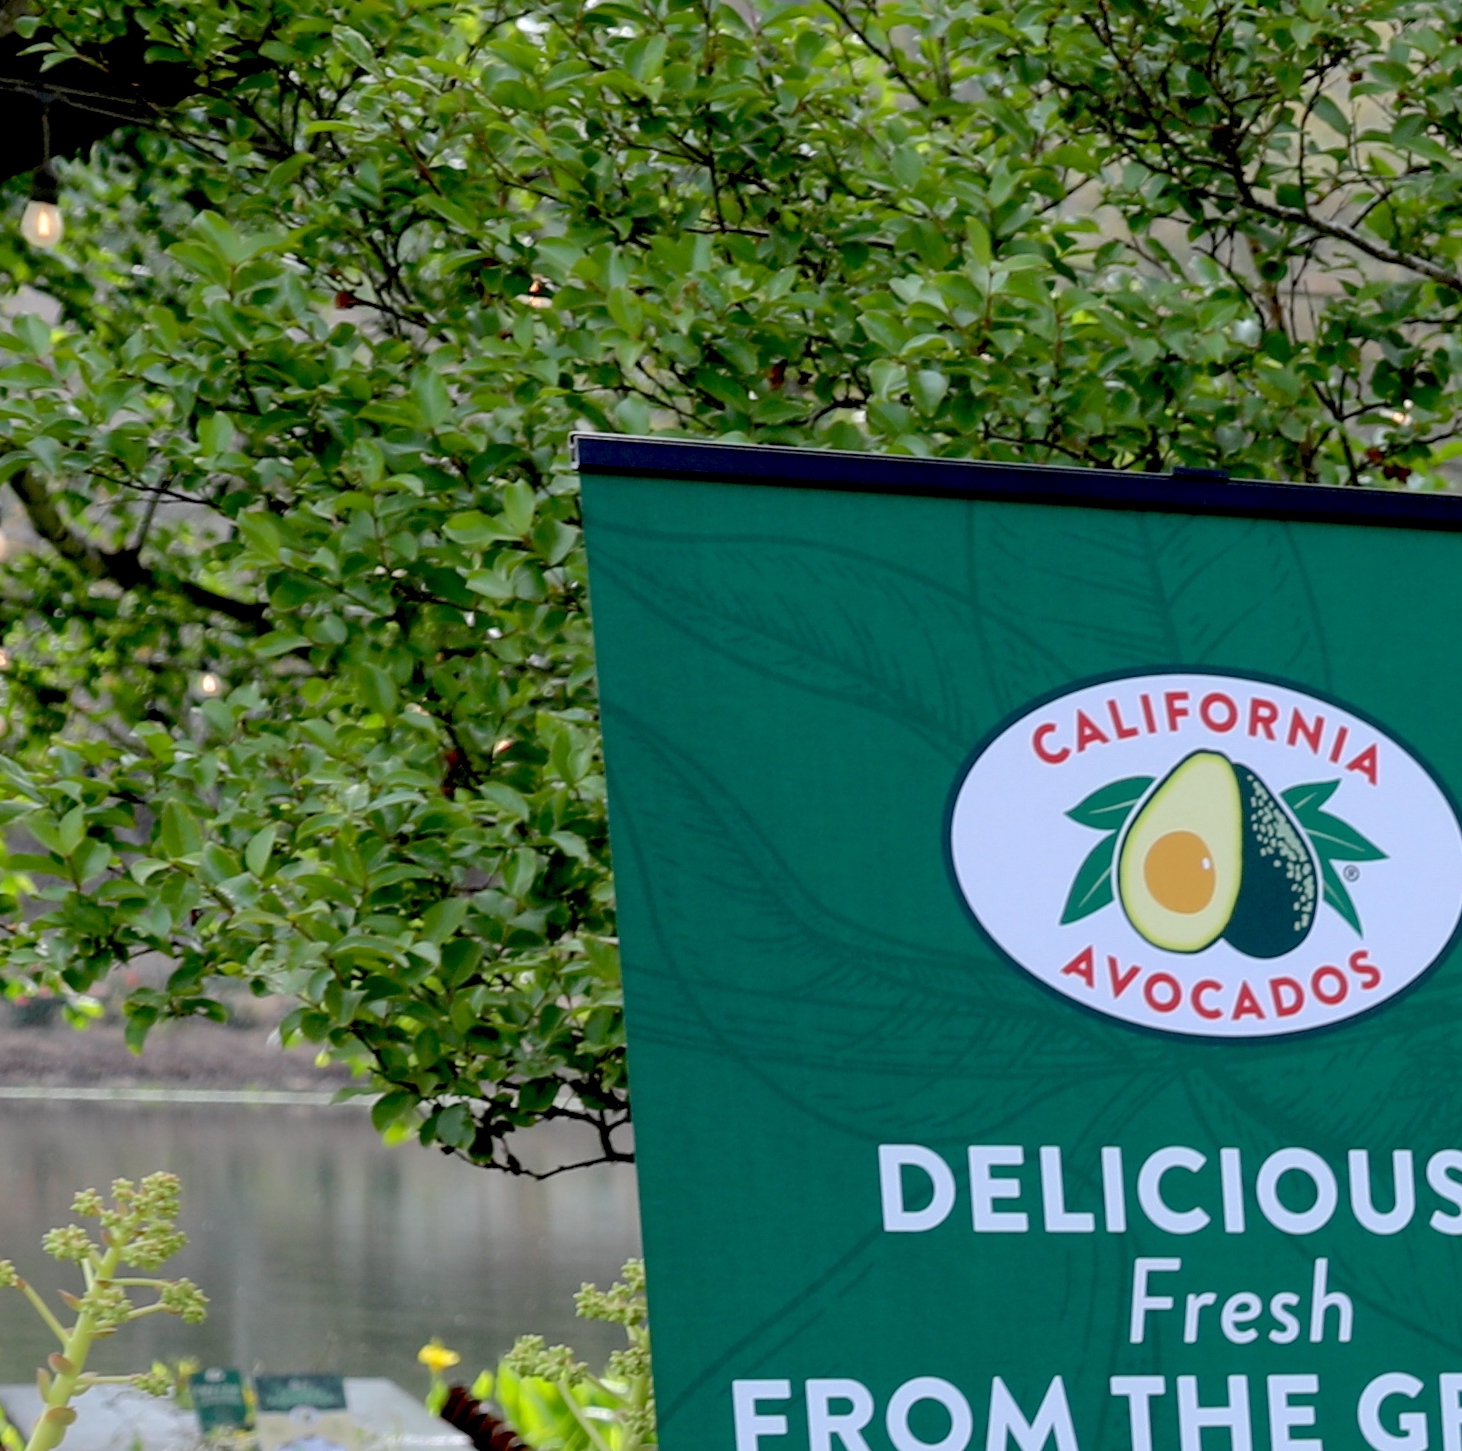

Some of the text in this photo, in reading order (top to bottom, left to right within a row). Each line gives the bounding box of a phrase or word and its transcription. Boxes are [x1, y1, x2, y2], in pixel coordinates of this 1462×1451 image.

[1032, 692, 1379, 786] CALIFORNIA
[1060, 945, 1382, 1021] AVOCADOS
[1129, 1258, 1354, 1345] Fresh
